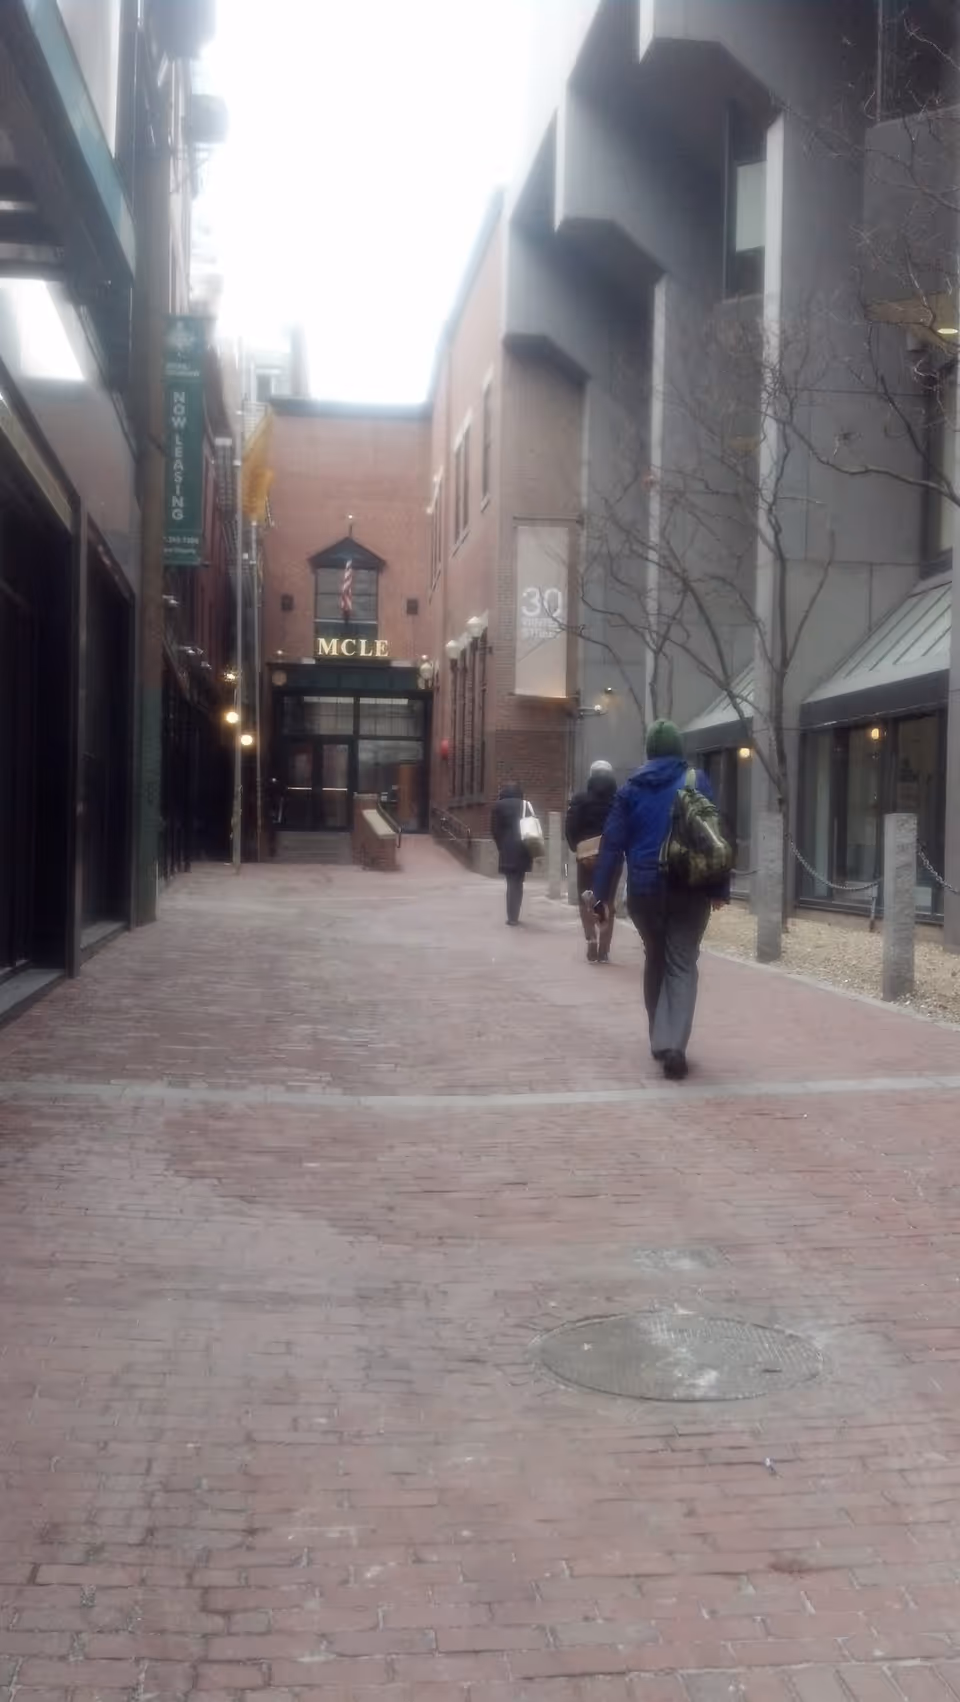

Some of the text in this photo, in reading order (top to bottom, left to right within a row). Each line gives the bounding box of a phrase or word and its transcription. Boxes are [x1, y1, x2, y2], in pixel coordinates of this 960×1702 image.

[171, 391, 187, 429] NOW
[171, 434, 185, 520] LEASING
[521, 587, 563, 617] 30
[317, 637, 389, 657] MCLE
